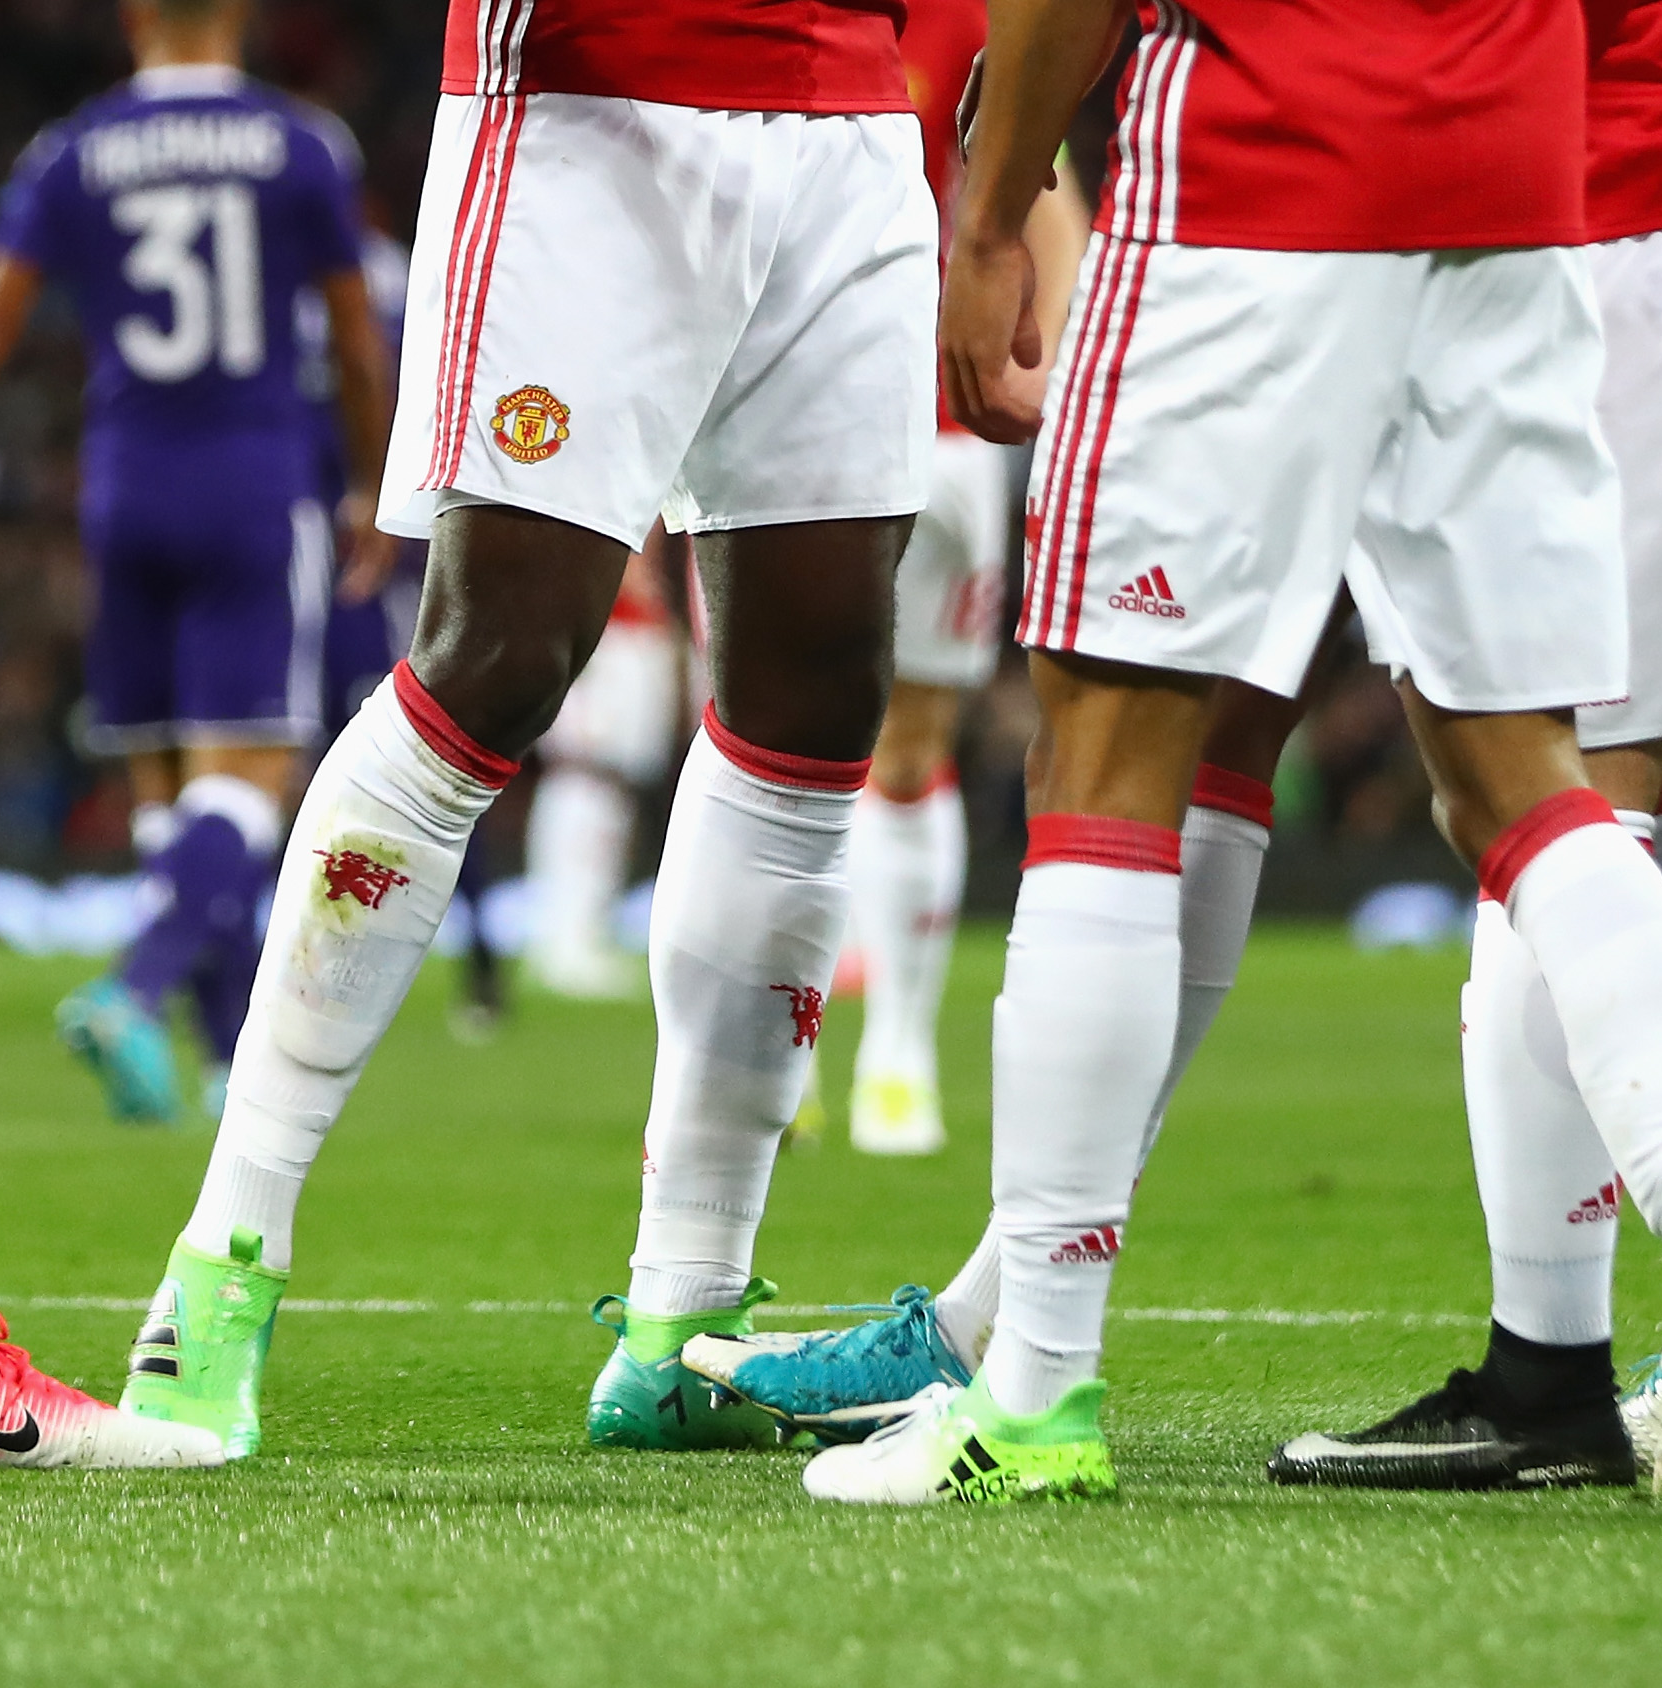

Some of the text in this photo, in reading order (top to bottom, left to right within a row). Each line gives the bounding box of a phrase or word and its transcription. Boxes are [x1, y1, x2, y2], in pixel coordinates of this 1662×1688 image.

[109, 182, 267, 383] 31
[501, 390, 564, 420] MANCHESTER
[504, 442, 548, 459] UNITED
[1109, 591, 1186, 619] adidas
